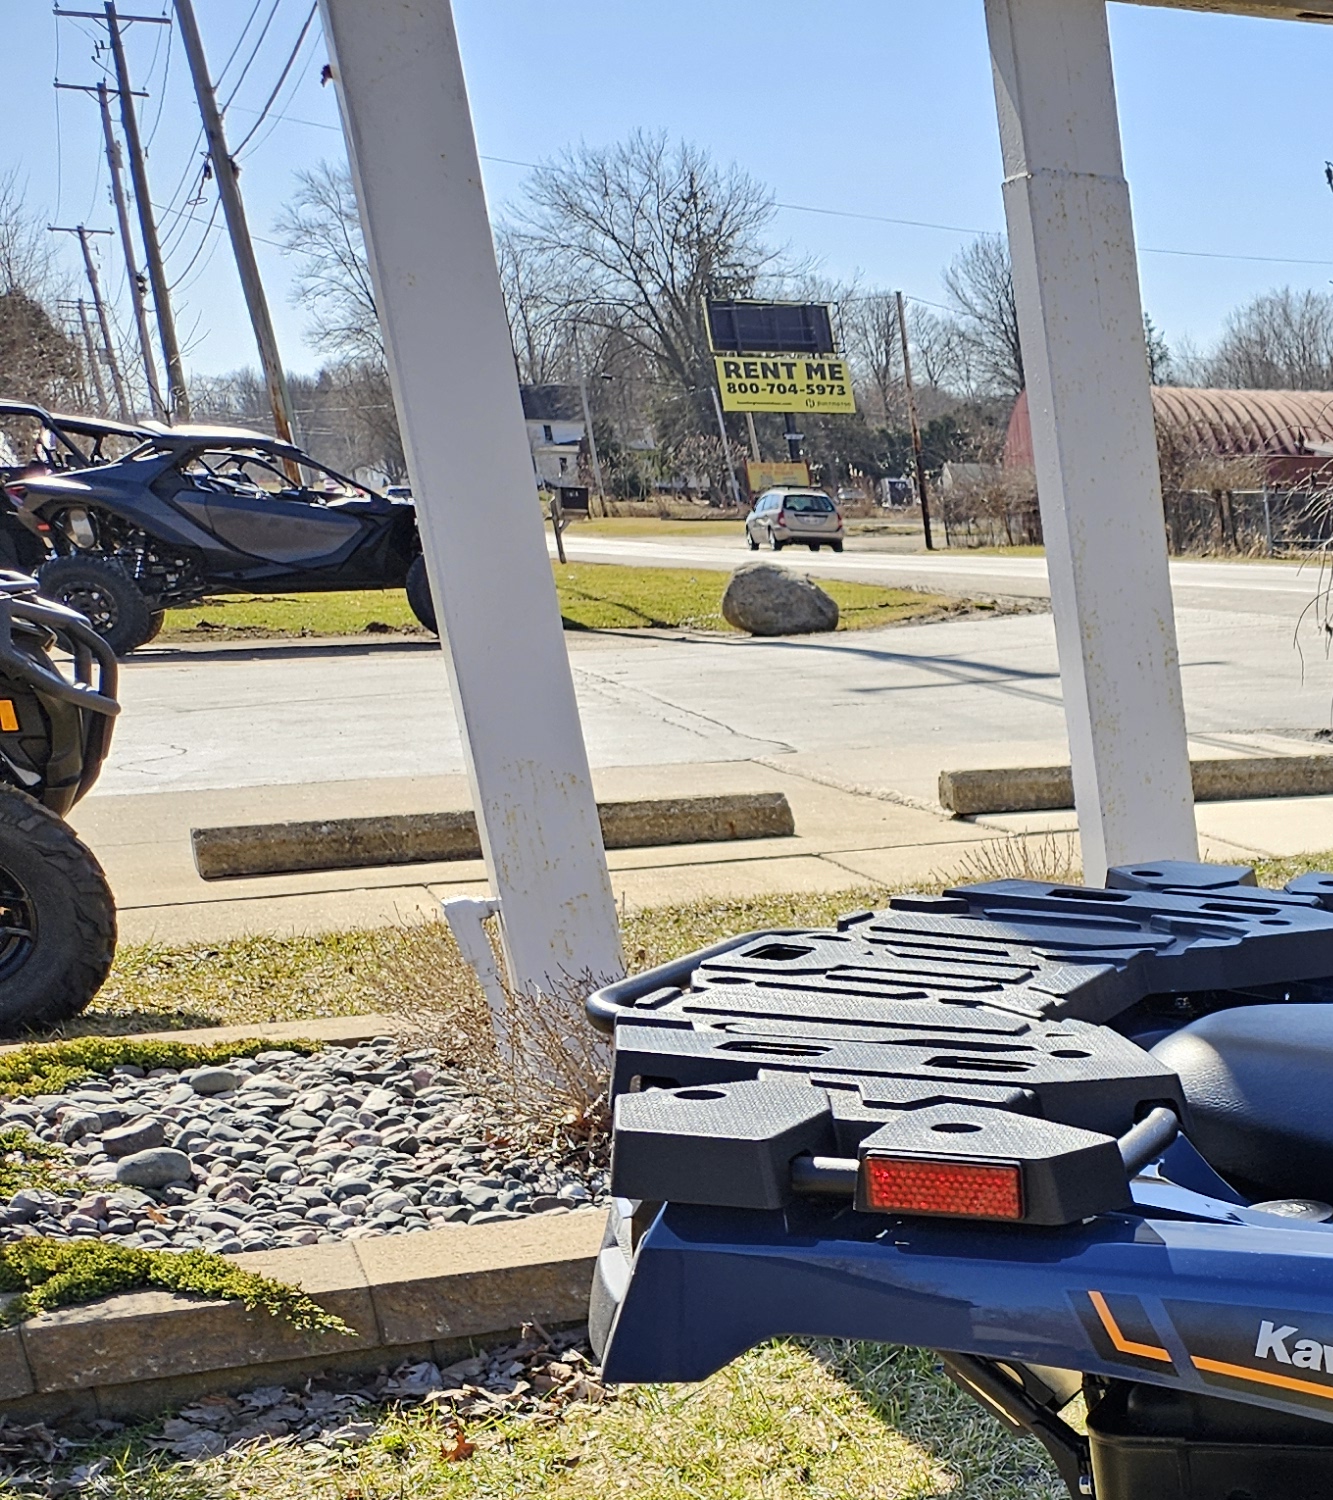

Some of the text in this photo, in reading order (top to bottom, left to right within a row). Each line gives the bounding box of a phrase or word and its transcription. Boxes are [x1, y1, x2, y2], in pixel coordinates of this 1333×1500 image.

[723, 361, 844, 381] RENT ME
[727, 382, 846, 396] 800-704-5973
